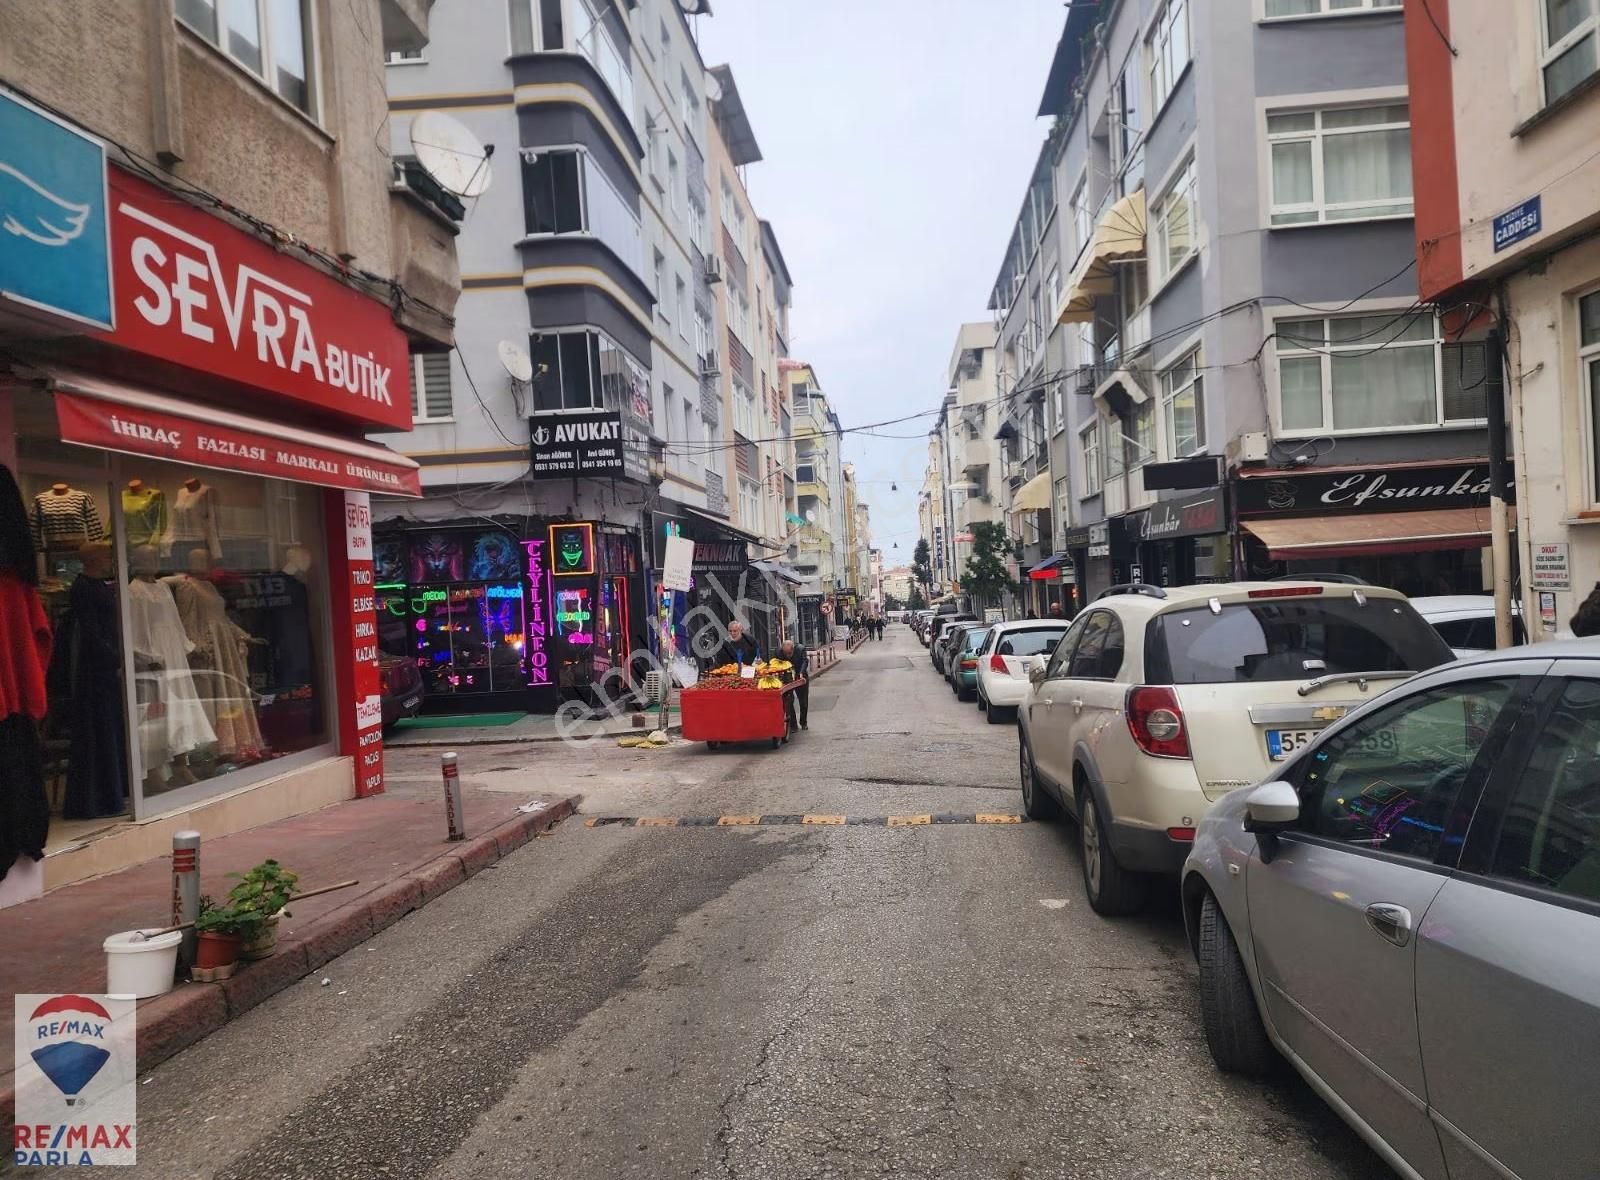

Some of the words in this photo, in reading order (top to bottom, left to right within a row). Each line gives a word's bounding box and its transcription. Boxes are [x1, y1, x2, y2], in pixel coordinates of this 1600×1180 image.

[1496, 210, 1537, 242] CADDESİ
[119, 202, 324, 383] SEVRA
[325, 343, 392, 406] BUTİK
[554, 421, 620, 442] AVUKAT
[111, 415, 181, 449] İHRAÇ
[197, 436, 265, 462] FAZLASI
[276, 452, 339, 475] MARKALI
[346, 461, 399, 485] ÜRÜNLER
[1320, 469, 1514, 505] Efsunkâ
[347, 503, 370, 529] SEVRA
[355, 646, 377, 662] KAZAK
